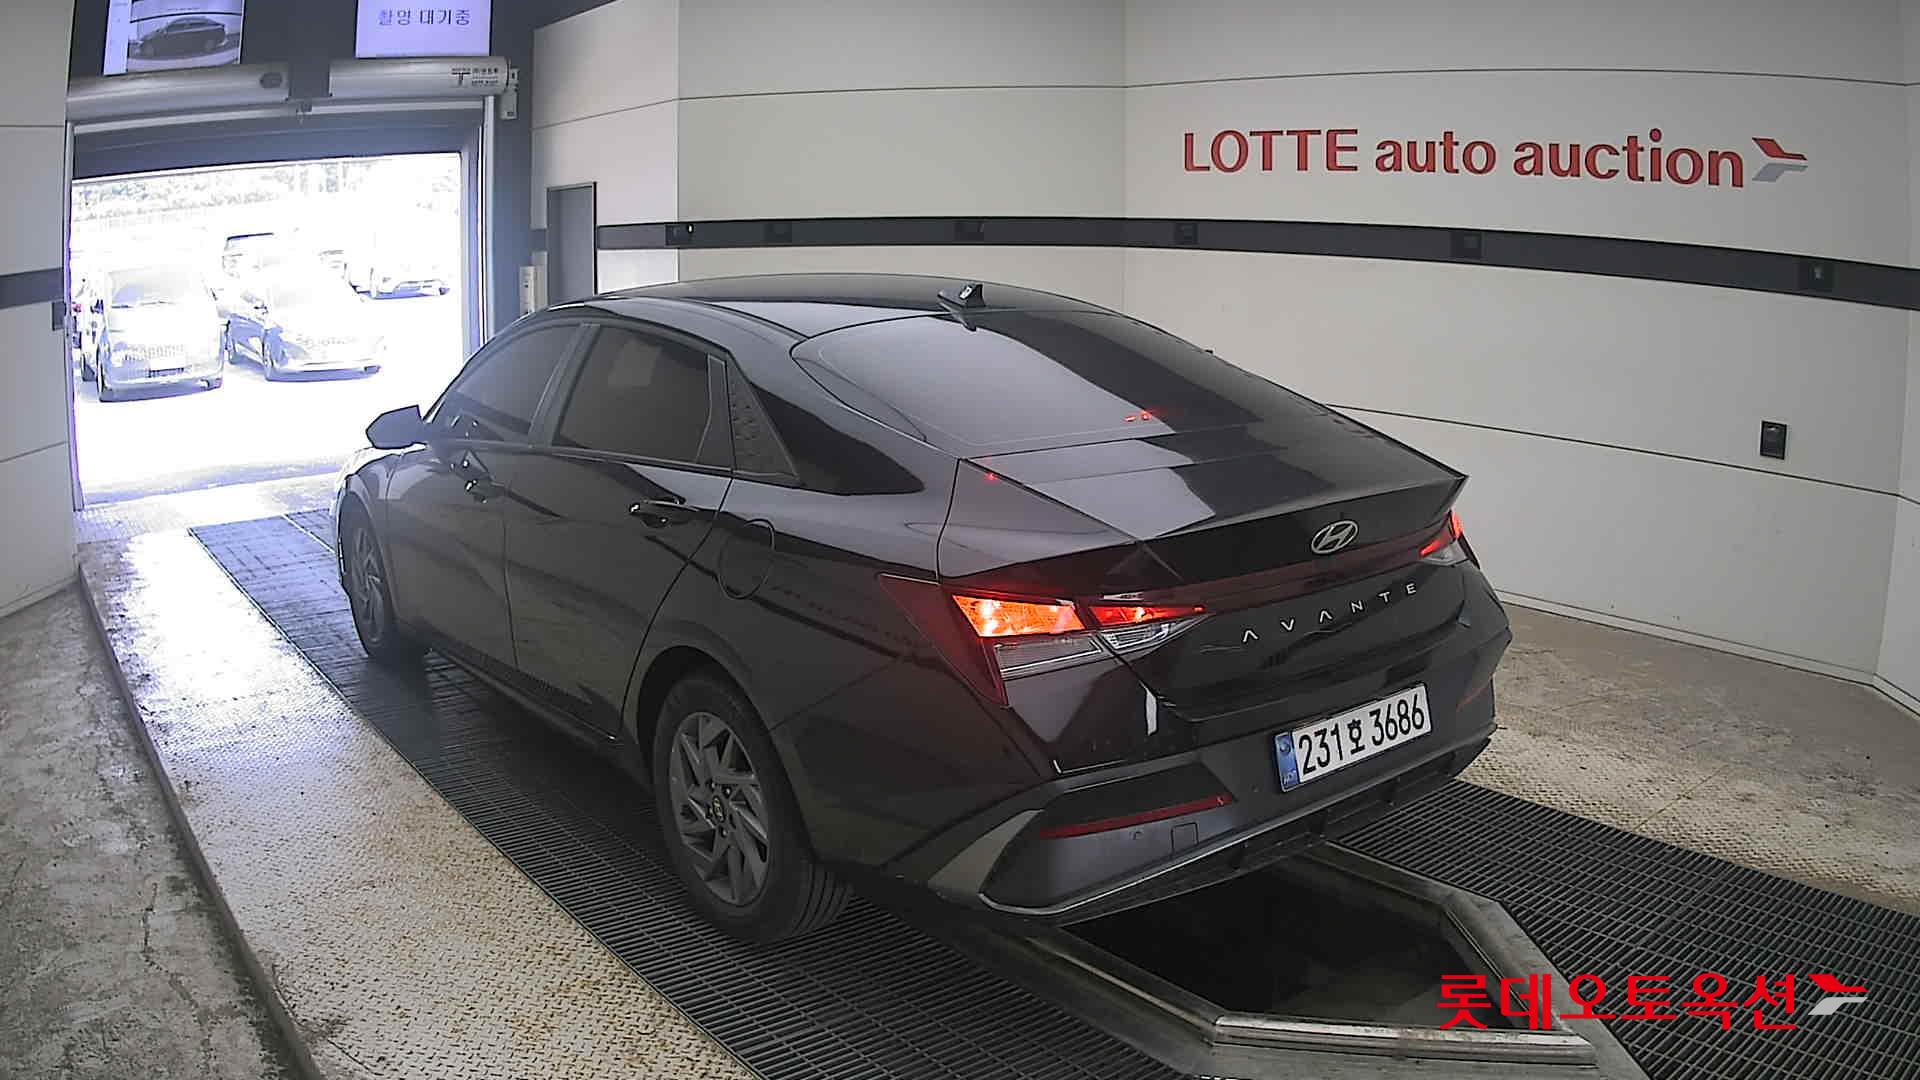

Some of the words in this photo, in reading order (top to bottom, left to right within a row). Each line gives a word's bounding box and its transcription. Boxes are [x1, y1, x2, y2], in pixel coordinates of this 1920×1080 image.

[1185, 129, 1358, 173] LOTTE
[1376, 131, 1496, 175] auto
[1513, 128, 1744, 188] auction
[1243, 583, 1417, 642] AVANTE
